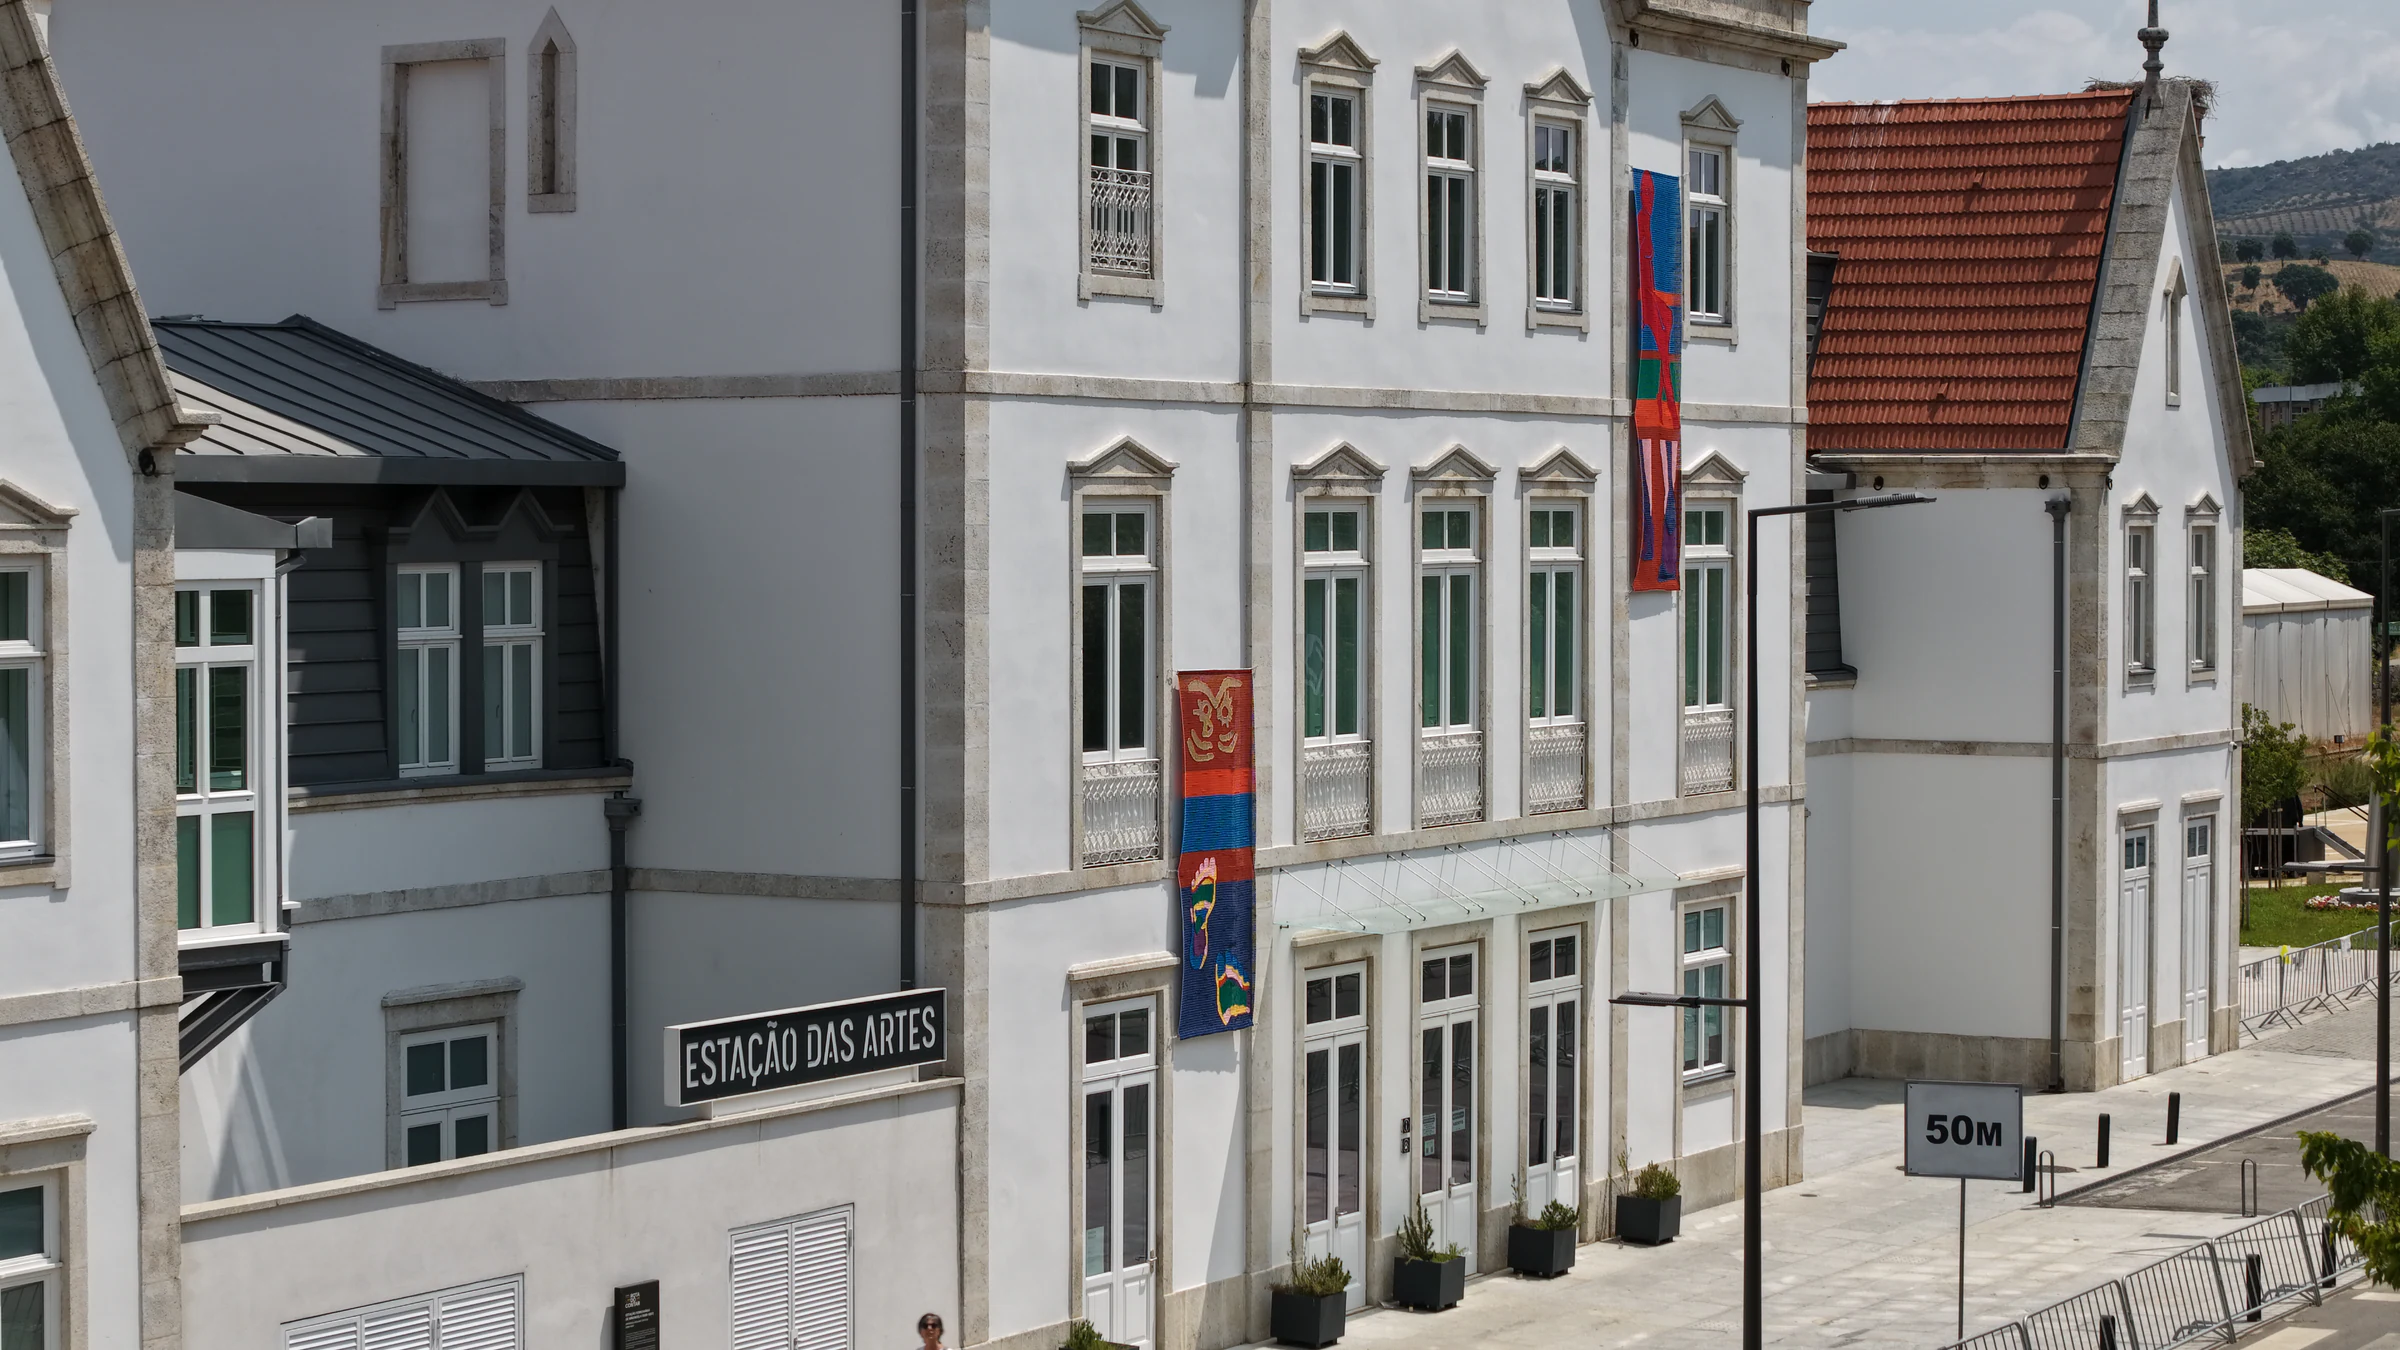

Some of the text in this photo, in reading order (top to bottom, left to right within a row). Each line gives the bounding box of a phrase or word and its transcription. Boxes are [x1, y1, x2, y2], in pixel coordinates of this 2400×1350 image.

[686, 1005, 936, 1089] ESTAÇÃO DAS ARTES
